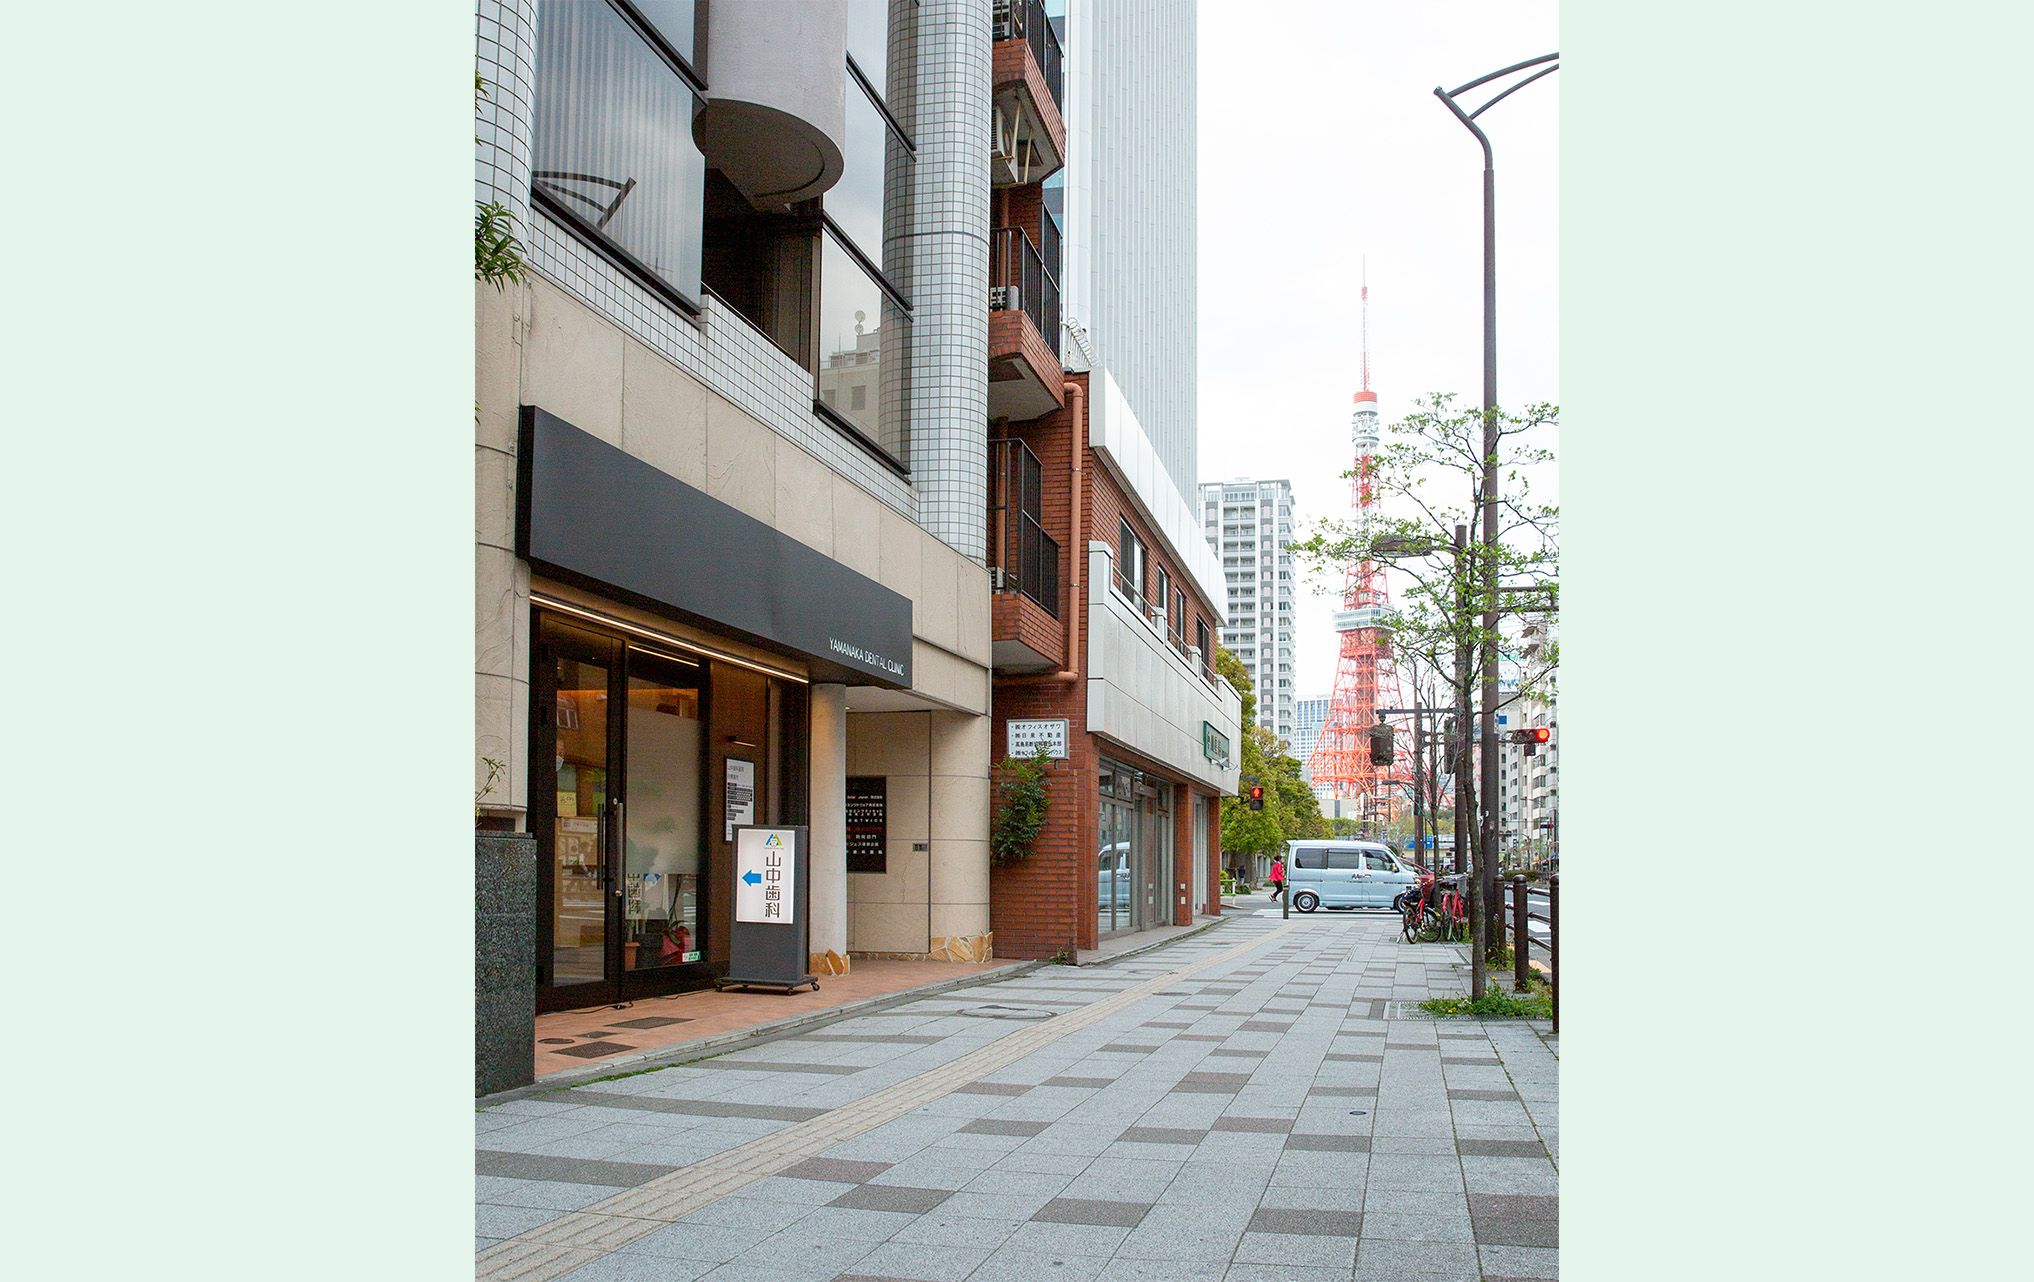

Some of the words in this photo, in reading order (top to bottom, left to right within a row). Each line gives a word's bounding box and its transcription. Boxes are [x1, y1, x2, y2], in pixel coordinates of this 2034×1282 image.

[829, 637, 864, 661] YAMANAKA
[865, 650, 887, 670] DENTAL
[888, 659, 904, 676] CLINIC
[765, 851, 781, 918] 山中歯科
